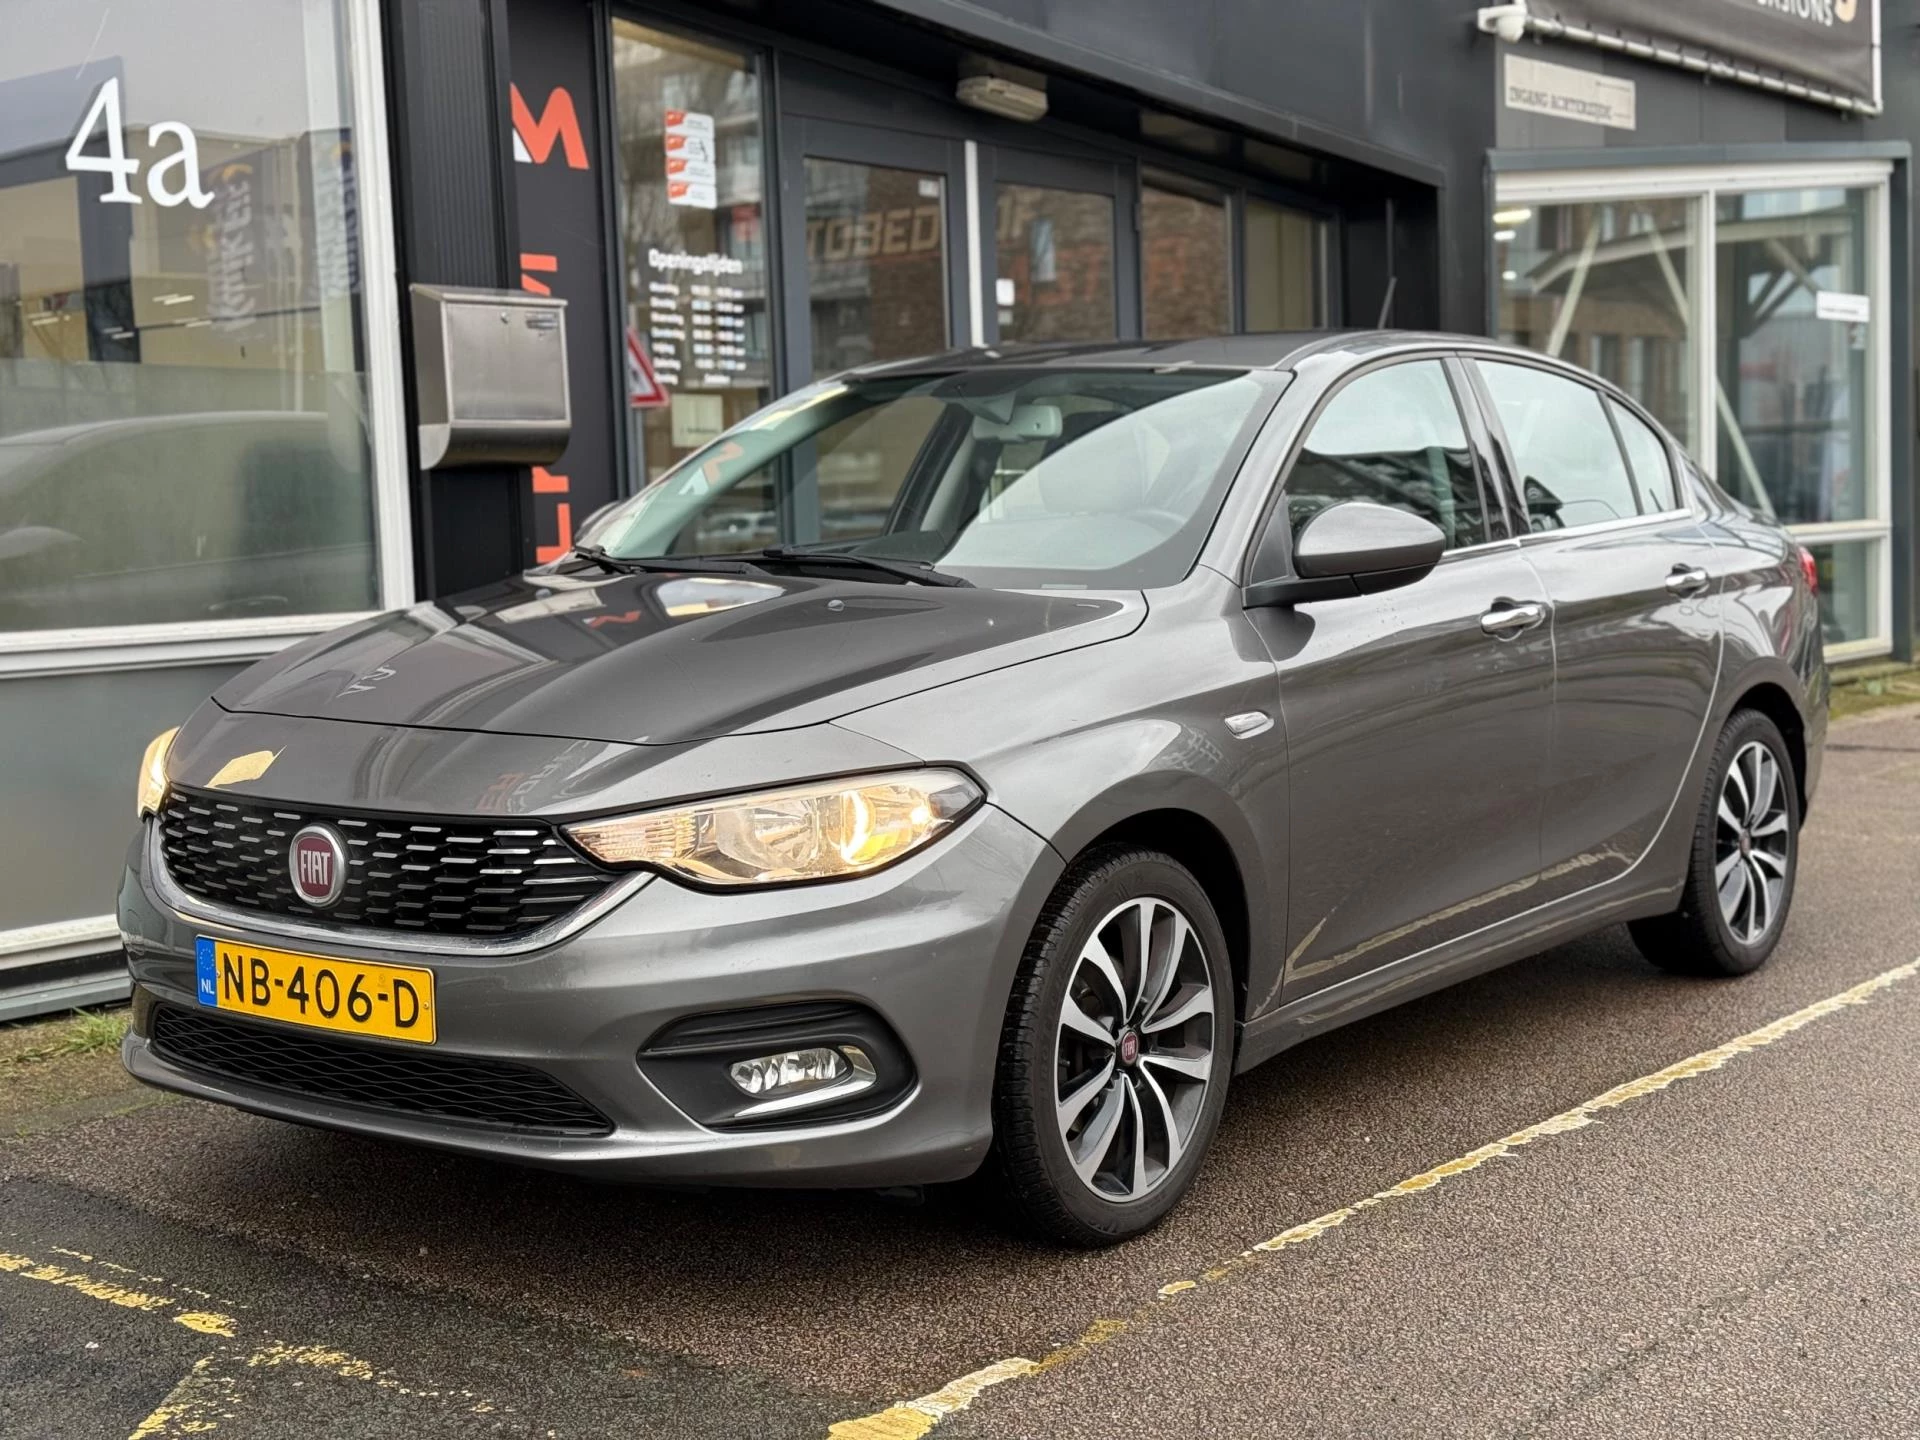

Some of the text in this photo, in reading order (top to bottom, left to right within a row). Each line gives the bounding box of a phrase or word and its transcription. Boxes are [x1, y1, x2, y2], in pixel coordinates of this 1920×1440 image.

[65, 76, 215, 209] 4a
[649, 249, 743, 277] Openingstijden
[300, 849, 331, 886] FIAT
[201, 977, 215, 995] NL
[223, 952, 420, 1028] NB-406-D
